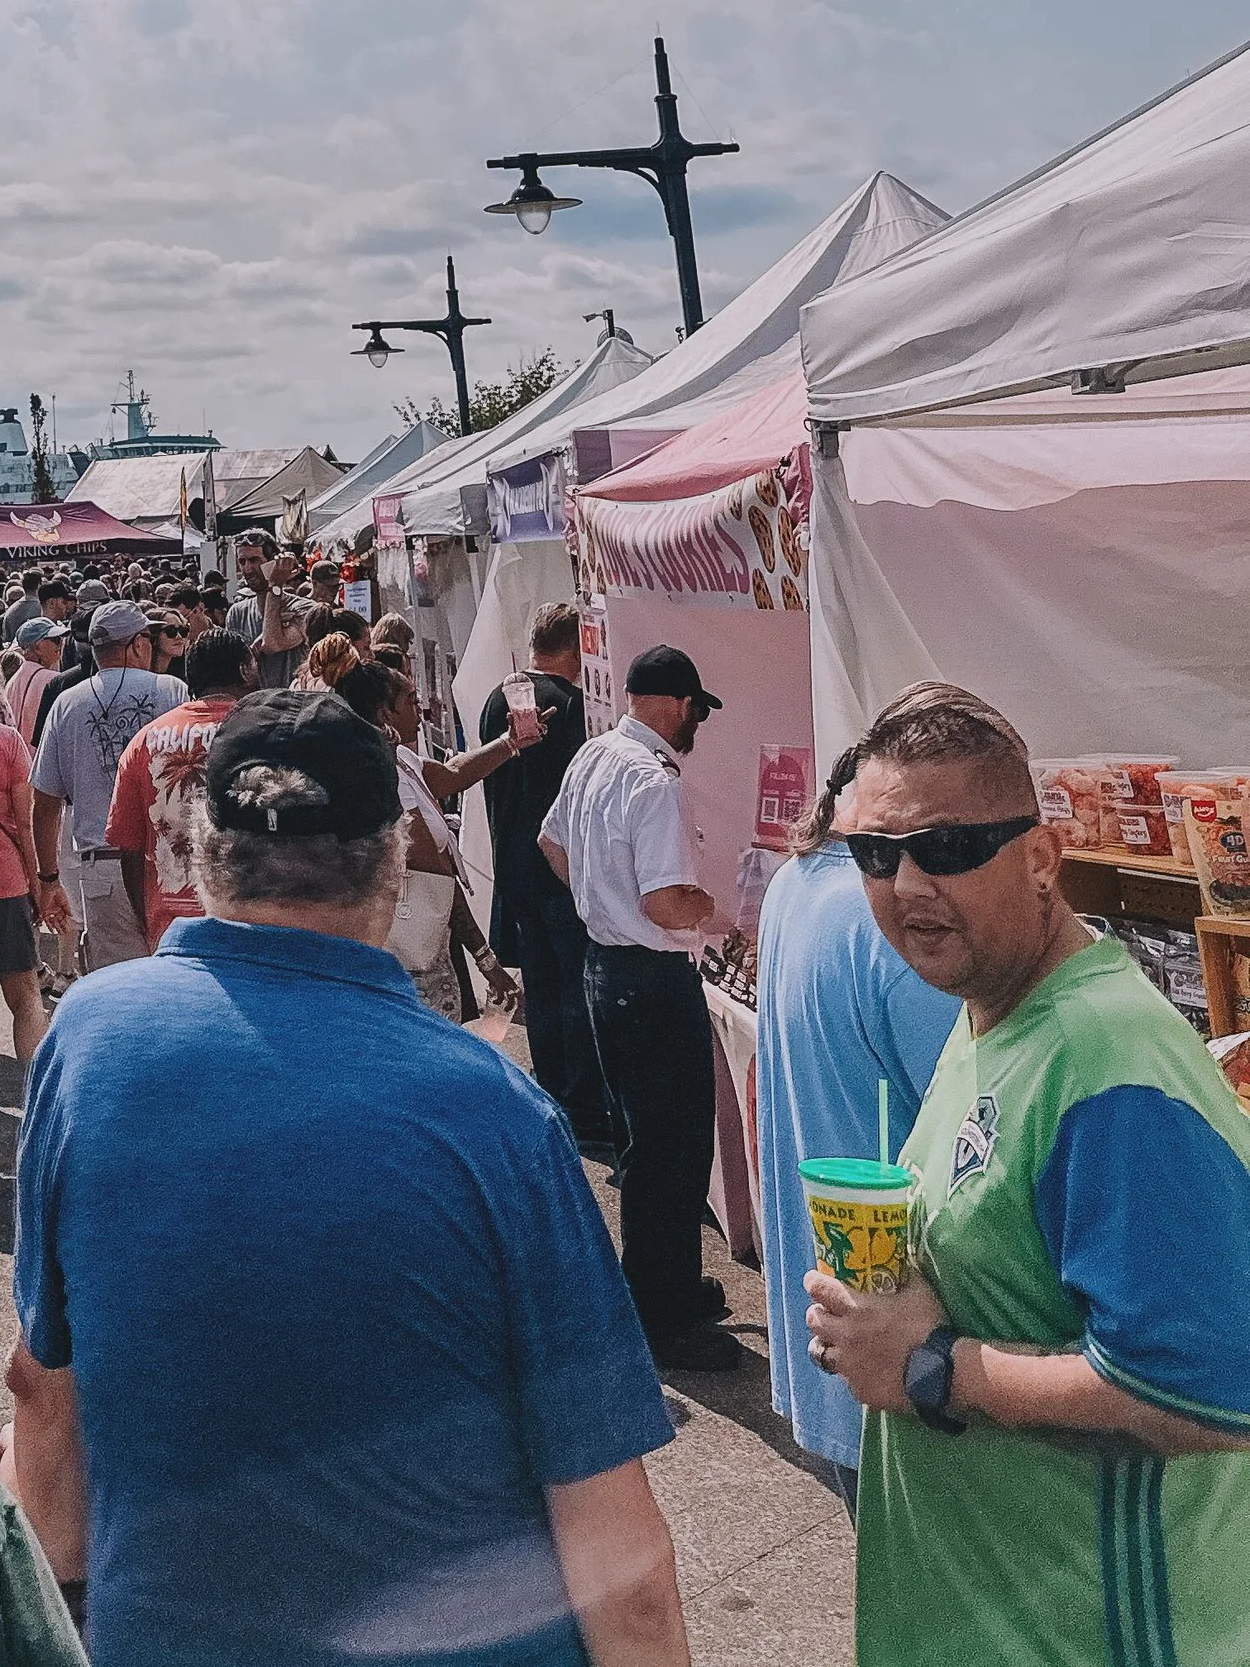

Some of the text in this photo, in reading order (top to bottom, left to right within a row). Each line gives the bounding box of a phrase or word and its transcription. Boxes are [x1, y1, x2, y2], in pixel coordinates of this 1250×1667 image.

[7, 541, 107, 559] VIKING CHIPS
[146, 722, 220, 755] CALIFO
[810, 1200, 908, 1223] ONADE LEMO
